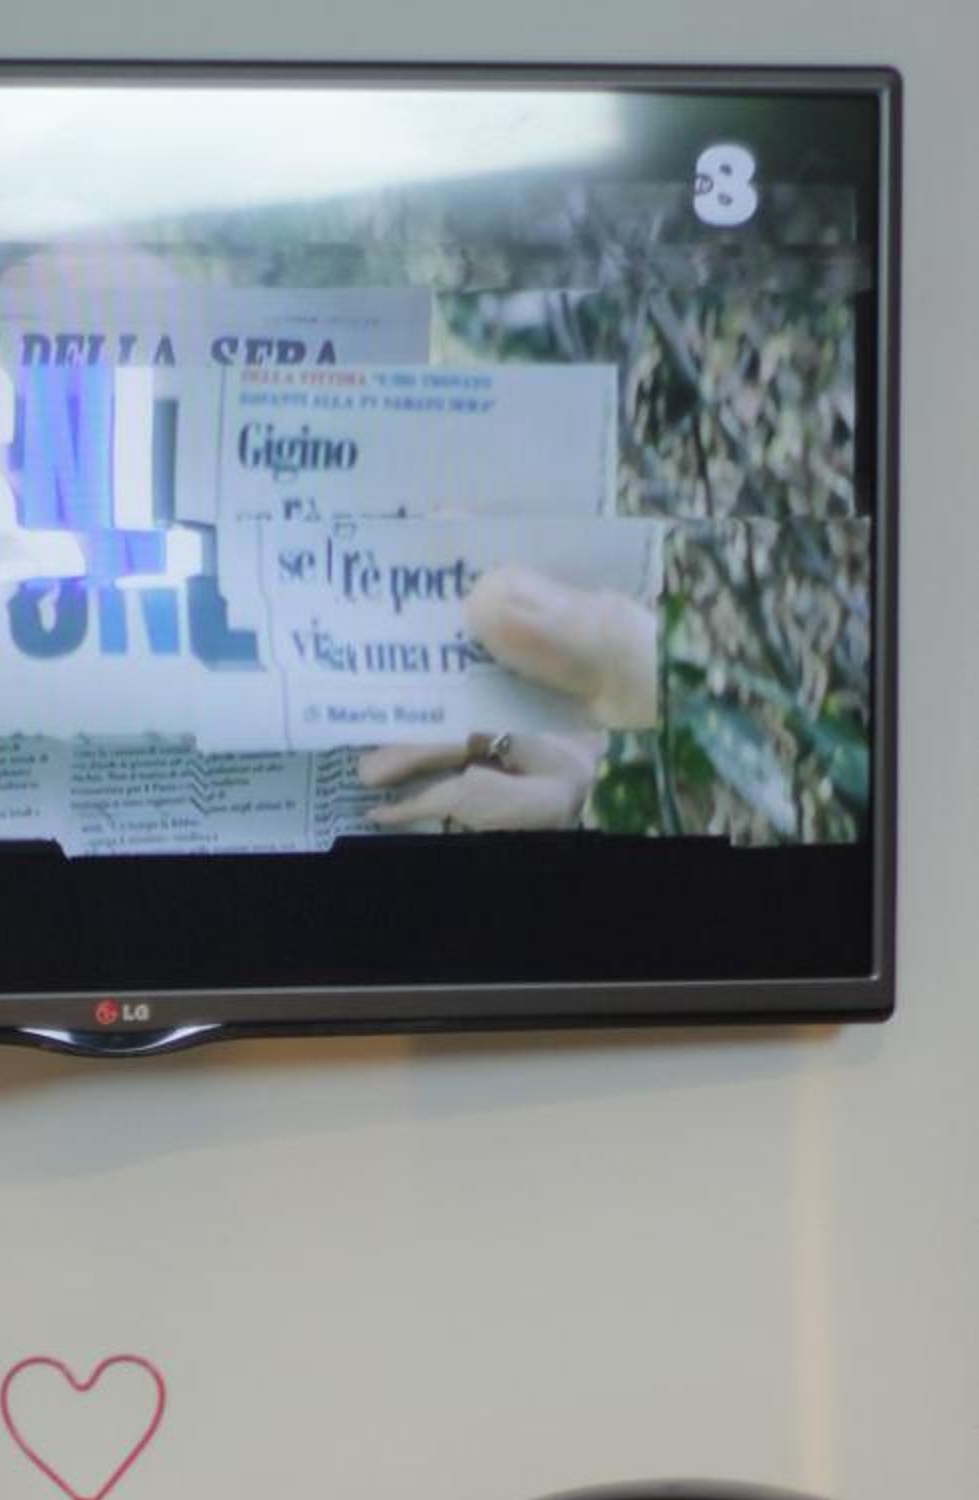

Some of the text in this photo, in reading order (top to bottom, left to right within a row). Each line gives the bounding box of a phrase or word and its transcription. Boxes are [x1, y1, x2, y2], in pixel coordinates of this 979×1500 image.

[695, 144, 758, 226] 8
[238, 421, 358, 480] Gigino
[123, 1003, 150, 1021] LG
